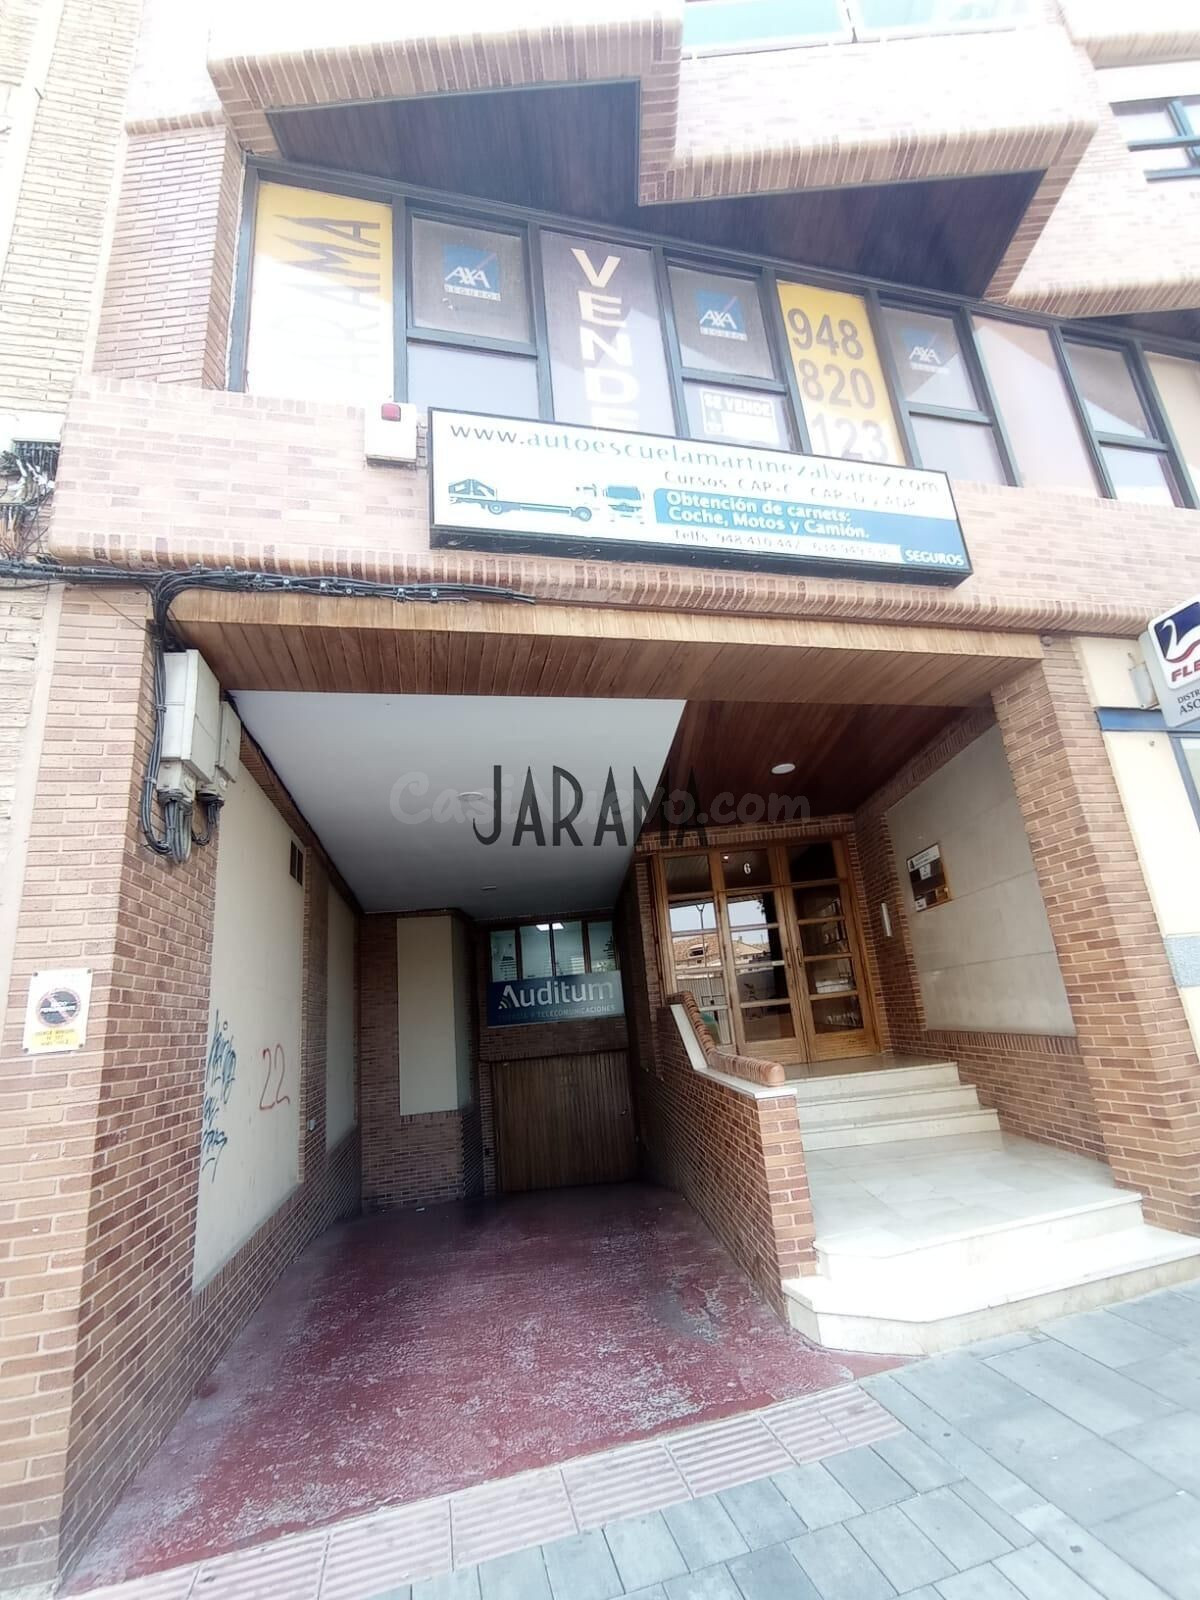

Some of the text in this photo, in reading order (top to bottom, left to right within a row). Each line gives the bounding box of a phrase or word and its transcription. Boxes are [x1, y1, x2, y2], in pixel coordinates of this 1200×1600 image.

[444, 266, 491, 289] AXA
[699, 309, 737, 330] AXA
[786, 308, 864, 360] 948
[908, 346, 942, 365] AXA
[798, 359, 876, 409] 820
[811, 412, 889, 463] 123
[666, 491, 851, 522] Obtención de carnets:
[668, 506, 870, 539] Coche, Motos y Camión.
[905, 550, 965, 566] SEGUROS
[743, 863, 752, 875] 6
[498, 980, 614, 1010] Auditum
[259, 1043, 290, 1112] 22
